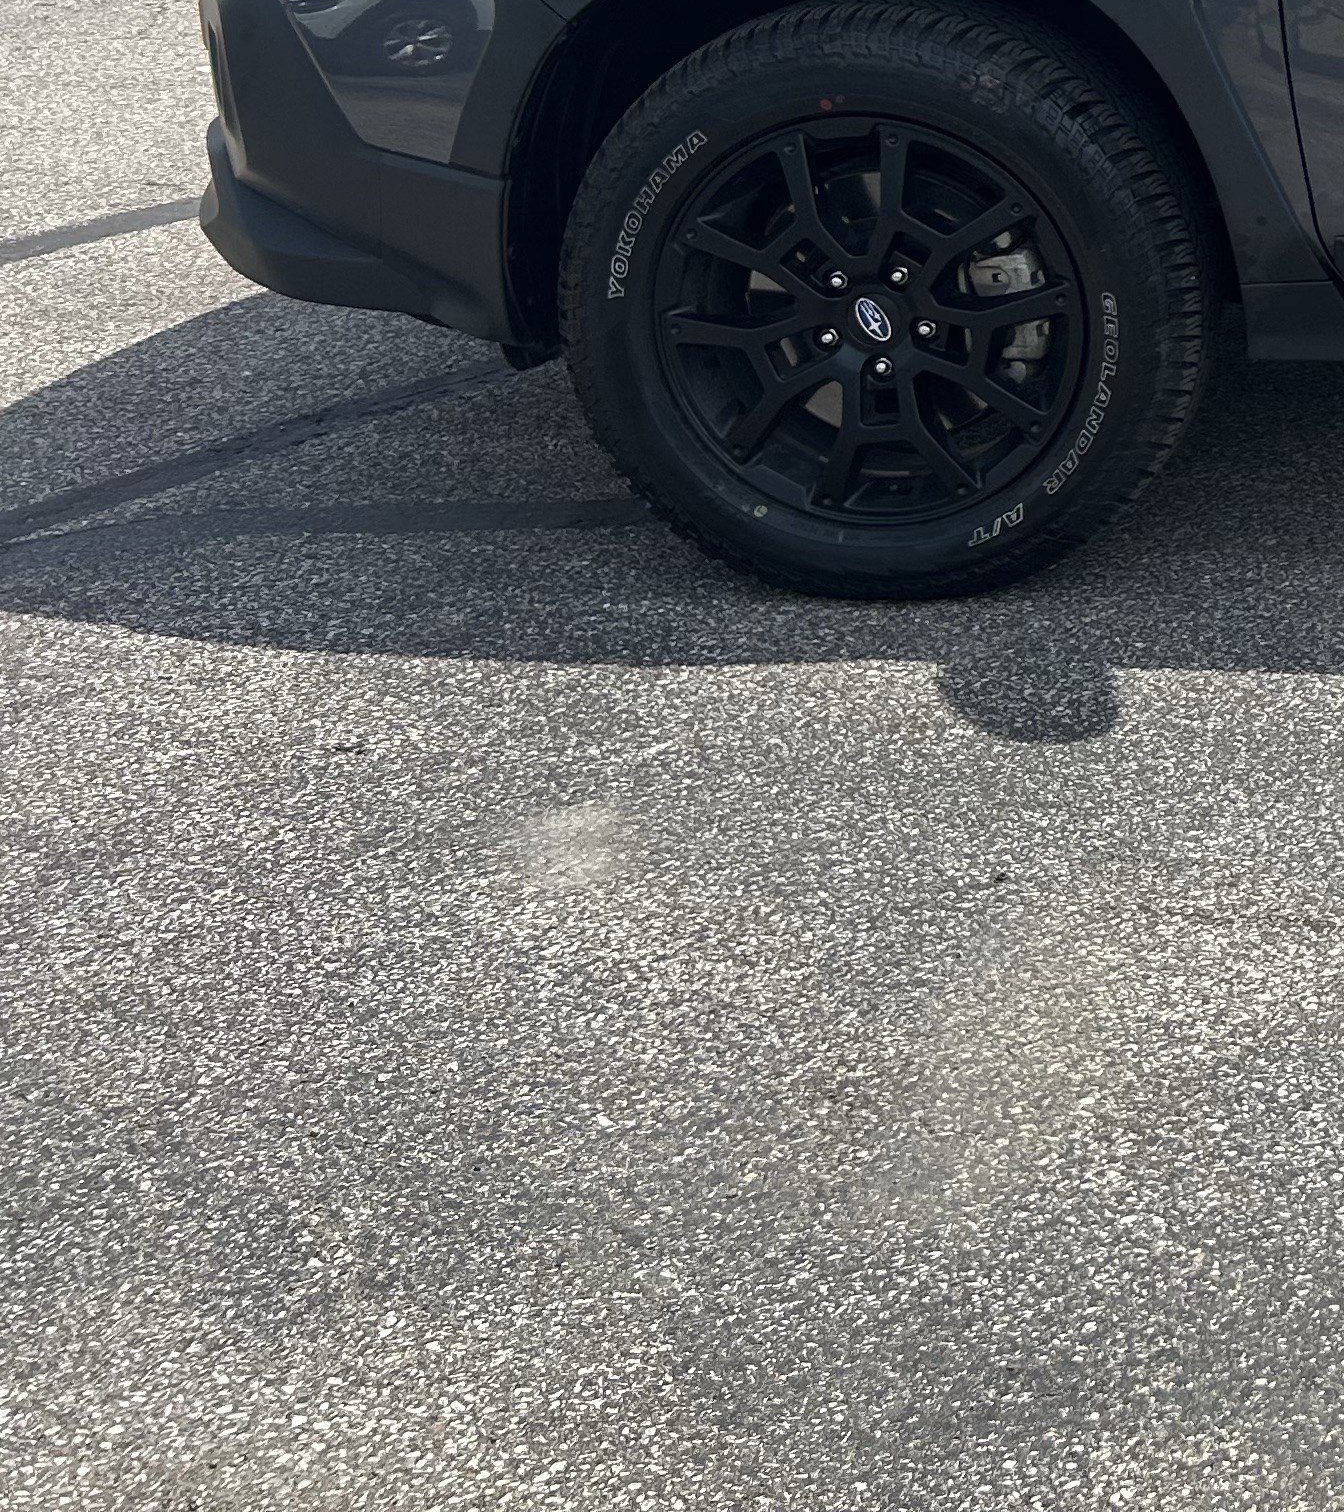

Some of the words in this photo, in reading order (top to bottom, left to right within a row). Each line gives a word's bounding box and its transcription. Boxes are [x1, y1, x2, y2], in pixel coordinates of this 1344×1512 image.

[607, 129, 708, 299] YOKOHAMA
[1043, 292, 1119, 494] GEOLANDAR
[968, 503, 1024, 547] A/T
